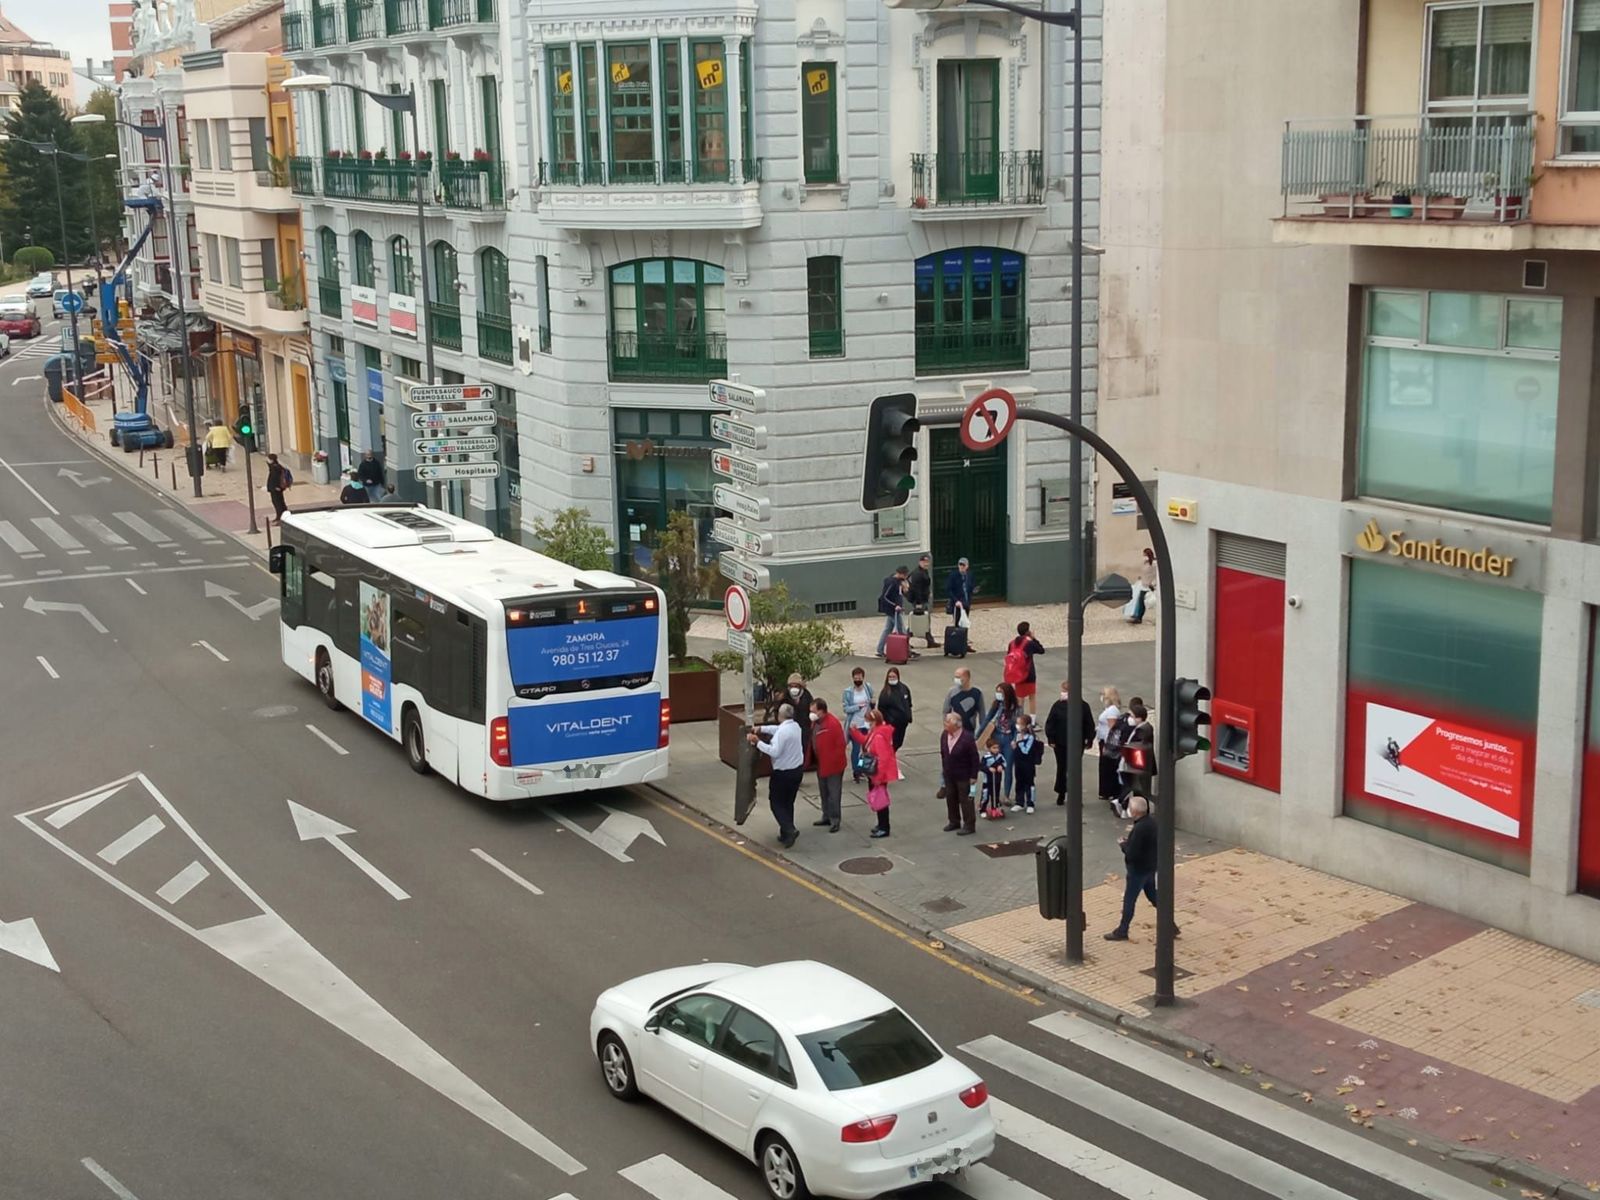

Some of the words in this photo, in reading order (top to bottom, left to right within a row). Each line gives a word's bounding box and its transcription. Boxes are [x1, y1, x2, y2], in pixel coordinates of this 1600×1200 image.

[448, 415, 494, 423] SALAMANCA
[455, 466, 496, 476] Hospitales
[1388, 530, 1515, 577] Santander
[578, 600, 586, 614] 1
[566, 632, 606, 643] ZAMORA
[540, 647, 569, 655] Avenida
[580, 643, 594, 651] Tres
[552, 653, 575, 667] 980
[578, 652, 590, 664] 51
[592, 651, 604, 663] 12
[606, 649, 620, 661] 37
[520, 685, 557, 695] CITARO
[546, 714, 633, 733] VITALDENT
